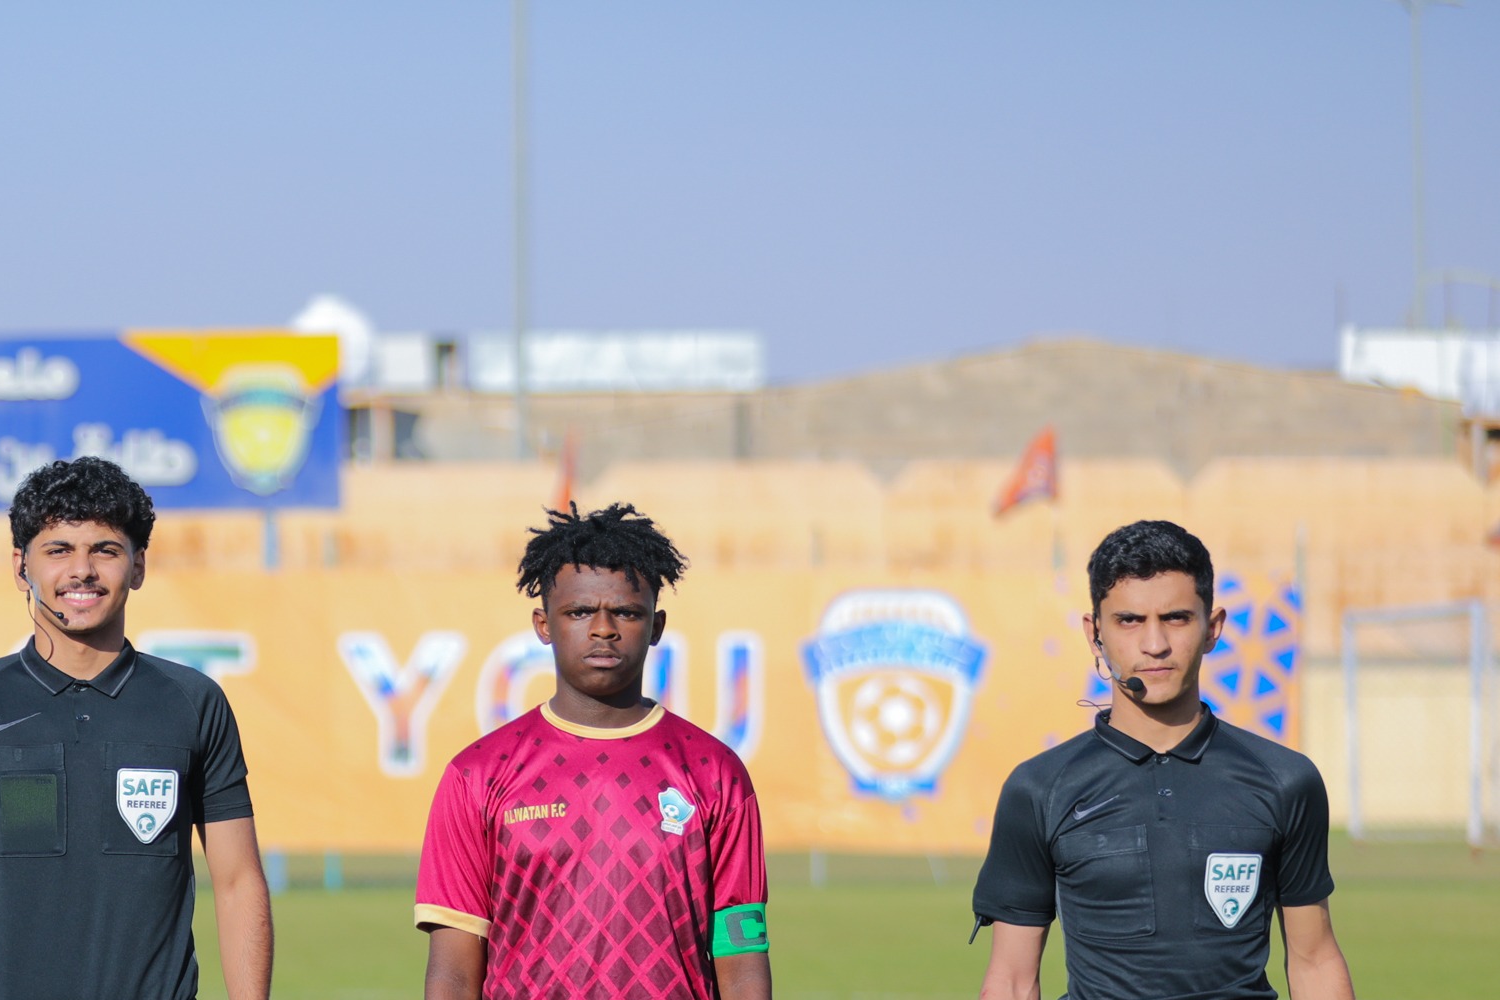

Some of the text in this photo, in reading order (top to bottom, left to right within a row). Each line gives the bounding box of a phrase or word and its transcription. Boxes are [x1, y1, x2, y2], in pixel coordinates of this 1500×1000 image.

[71, 422, 199, 487] طاق
[123, 778, 172, 796] SAFF
[127, 800, 167, 809] REFEREE
[504, 803, 566, 825] ALWATAN F.C
[1212, 863, 1256, 881] SAFF
[1214, 885, 1250, 893] REFEREE
[724, 910, 767, 949] C
